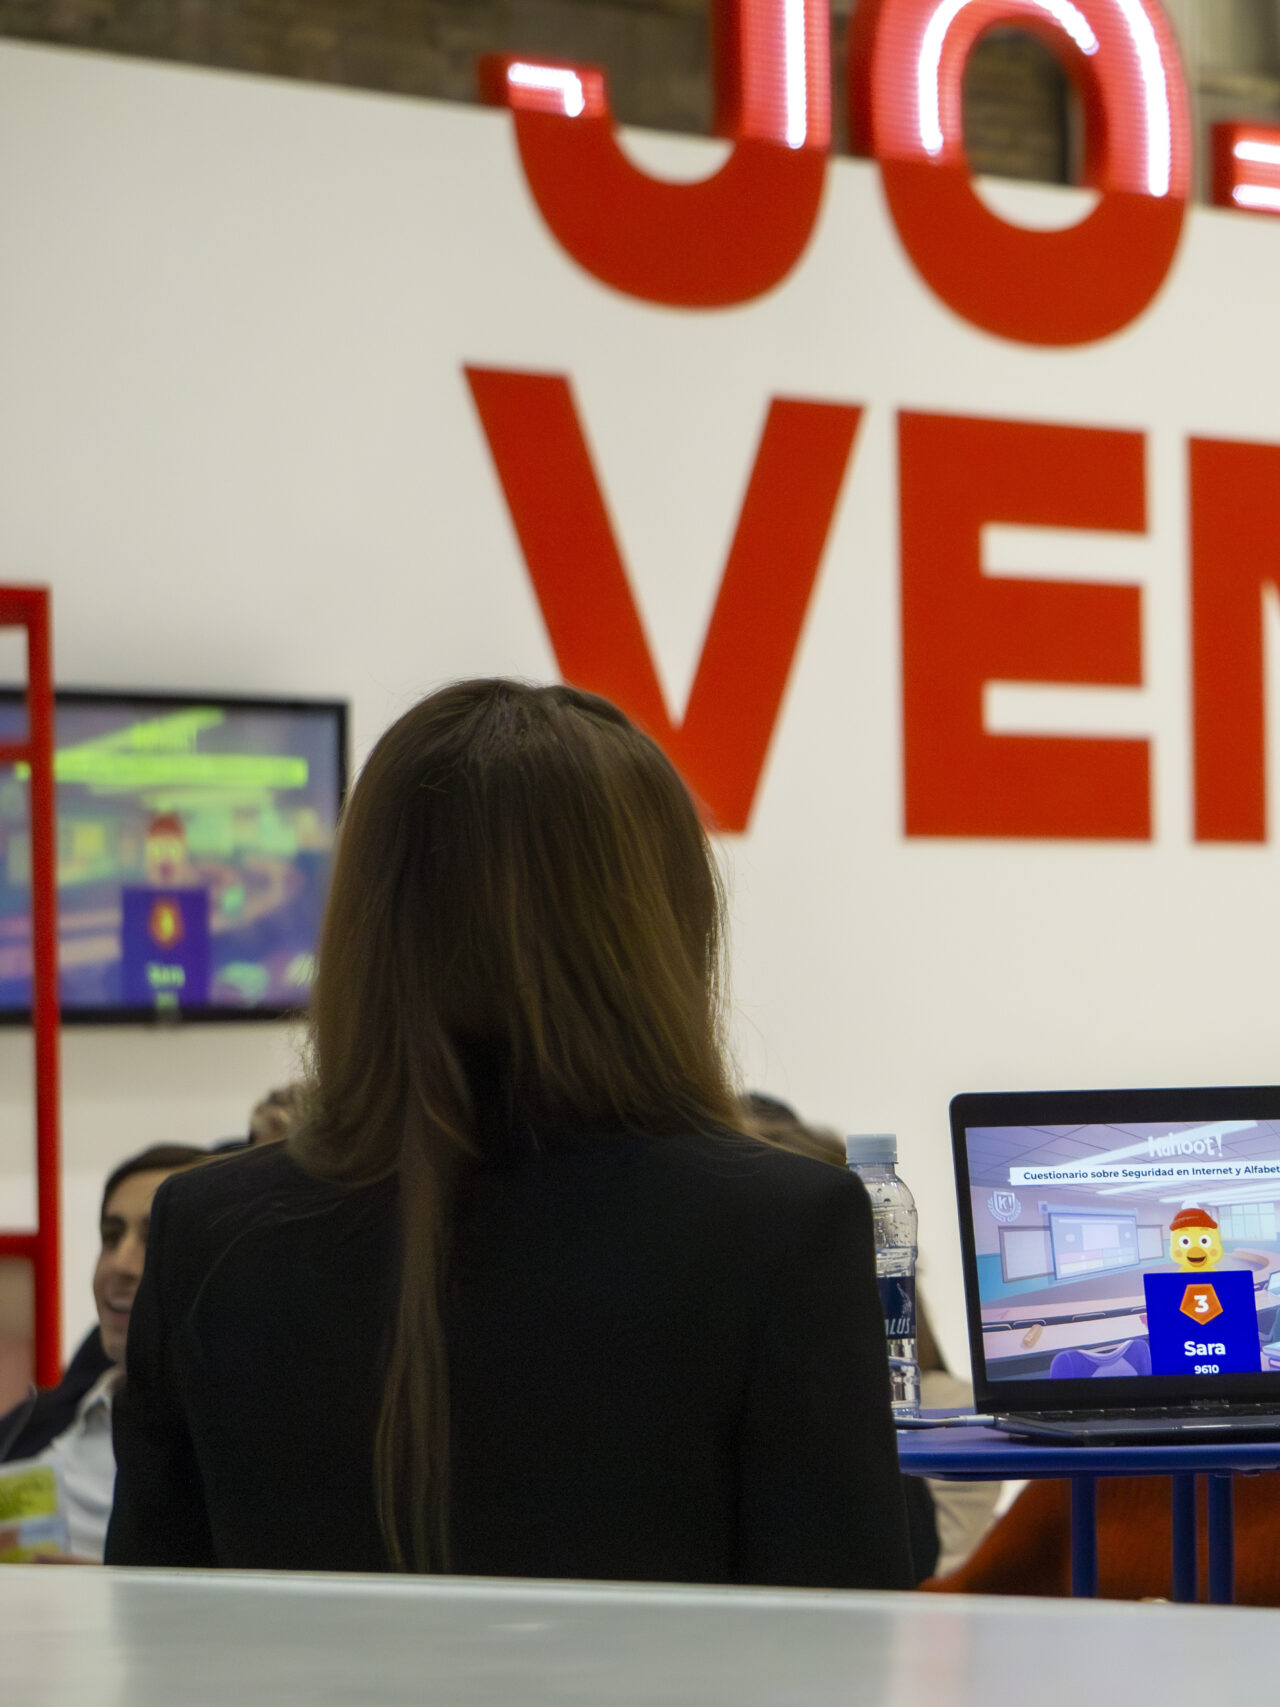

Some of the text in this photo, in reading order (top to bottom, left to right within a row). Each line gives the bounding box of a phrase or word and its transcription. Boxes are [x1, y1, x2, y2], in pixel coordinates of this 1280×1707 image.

[1147, 1131, 1223, 1158] Kahoot!
[1023, 1170, 1088, 1180] Cuestionario
[1090, 1168, 1119, 1179] sobre
[1122, 1167, 1174, 1179] Seguridad
[1176, 1168, 1190, 1176] en
[1192, 1166, 1233, 1176] Internet
[1235, 1167, 1242, 1176] y
[1193, 1294, 1210, 1313] 3
[1183, 1340, 1227, 1357] Sara
[1193, 1363, 1220, 1375] 9610
